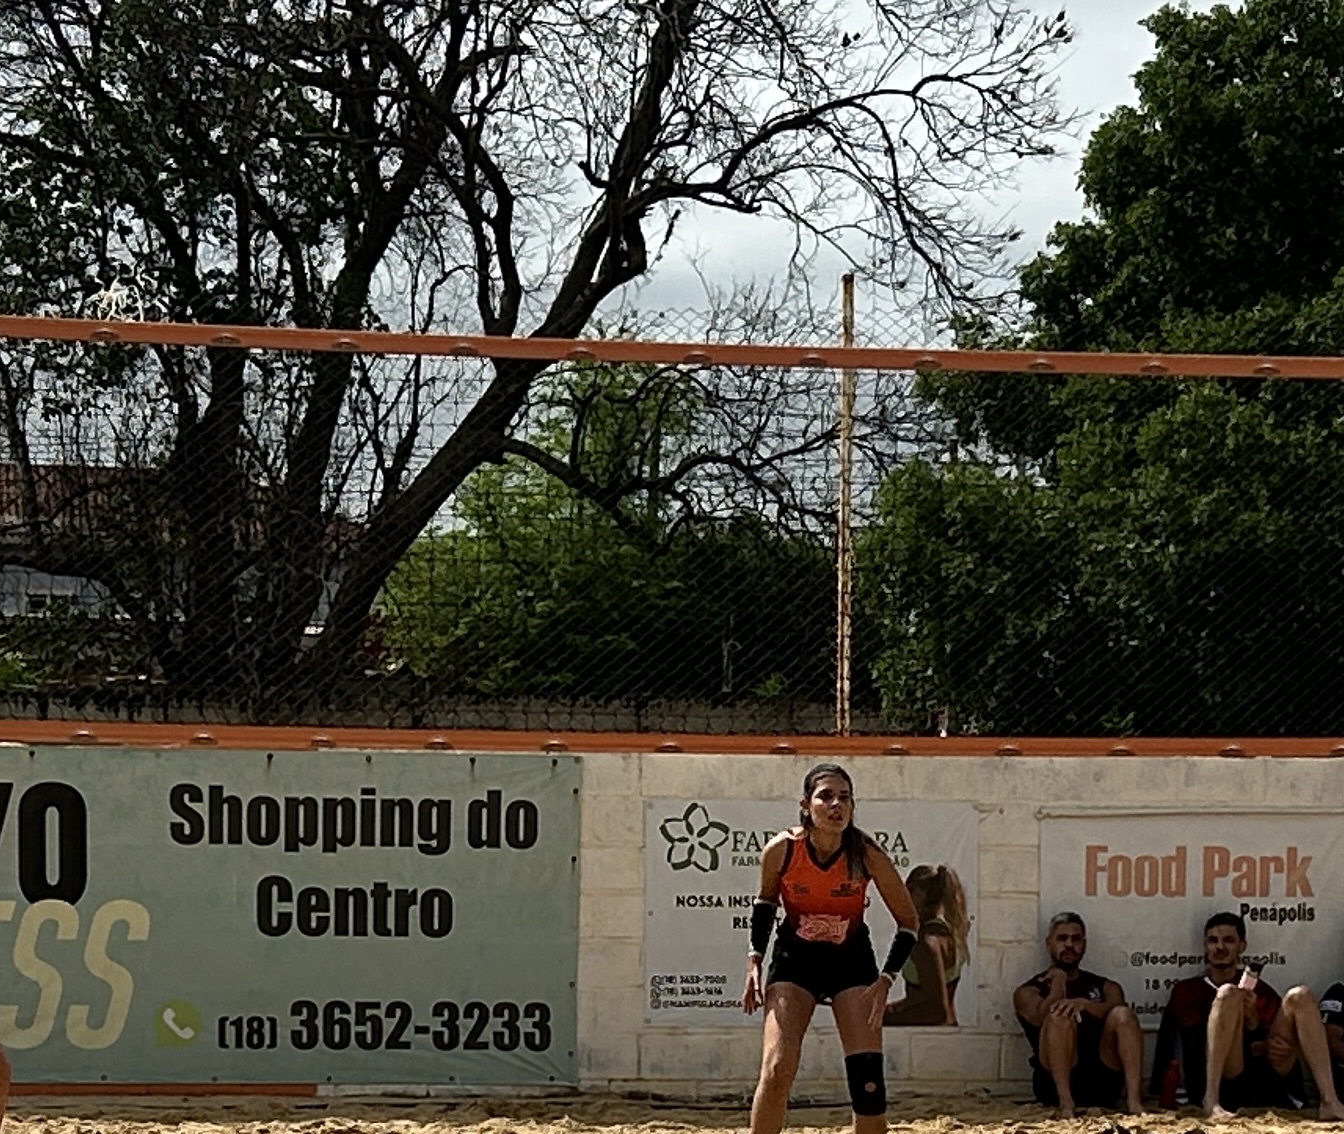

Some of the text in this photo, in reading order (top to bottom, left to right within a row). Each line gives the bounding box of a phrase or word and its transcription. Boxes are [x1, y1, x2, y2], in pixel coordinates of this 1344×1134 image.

[169, 783, 539, 856] Shopping do
[1084, 844, 1315, 898] Food Park
[256, 875, 454, 938] Centro
[675, 895, 724, 908] NOSSA
[1239, 902, 1316, 926] Penápolis
[217, 999, 552, 1052] (18) 3652-3233
